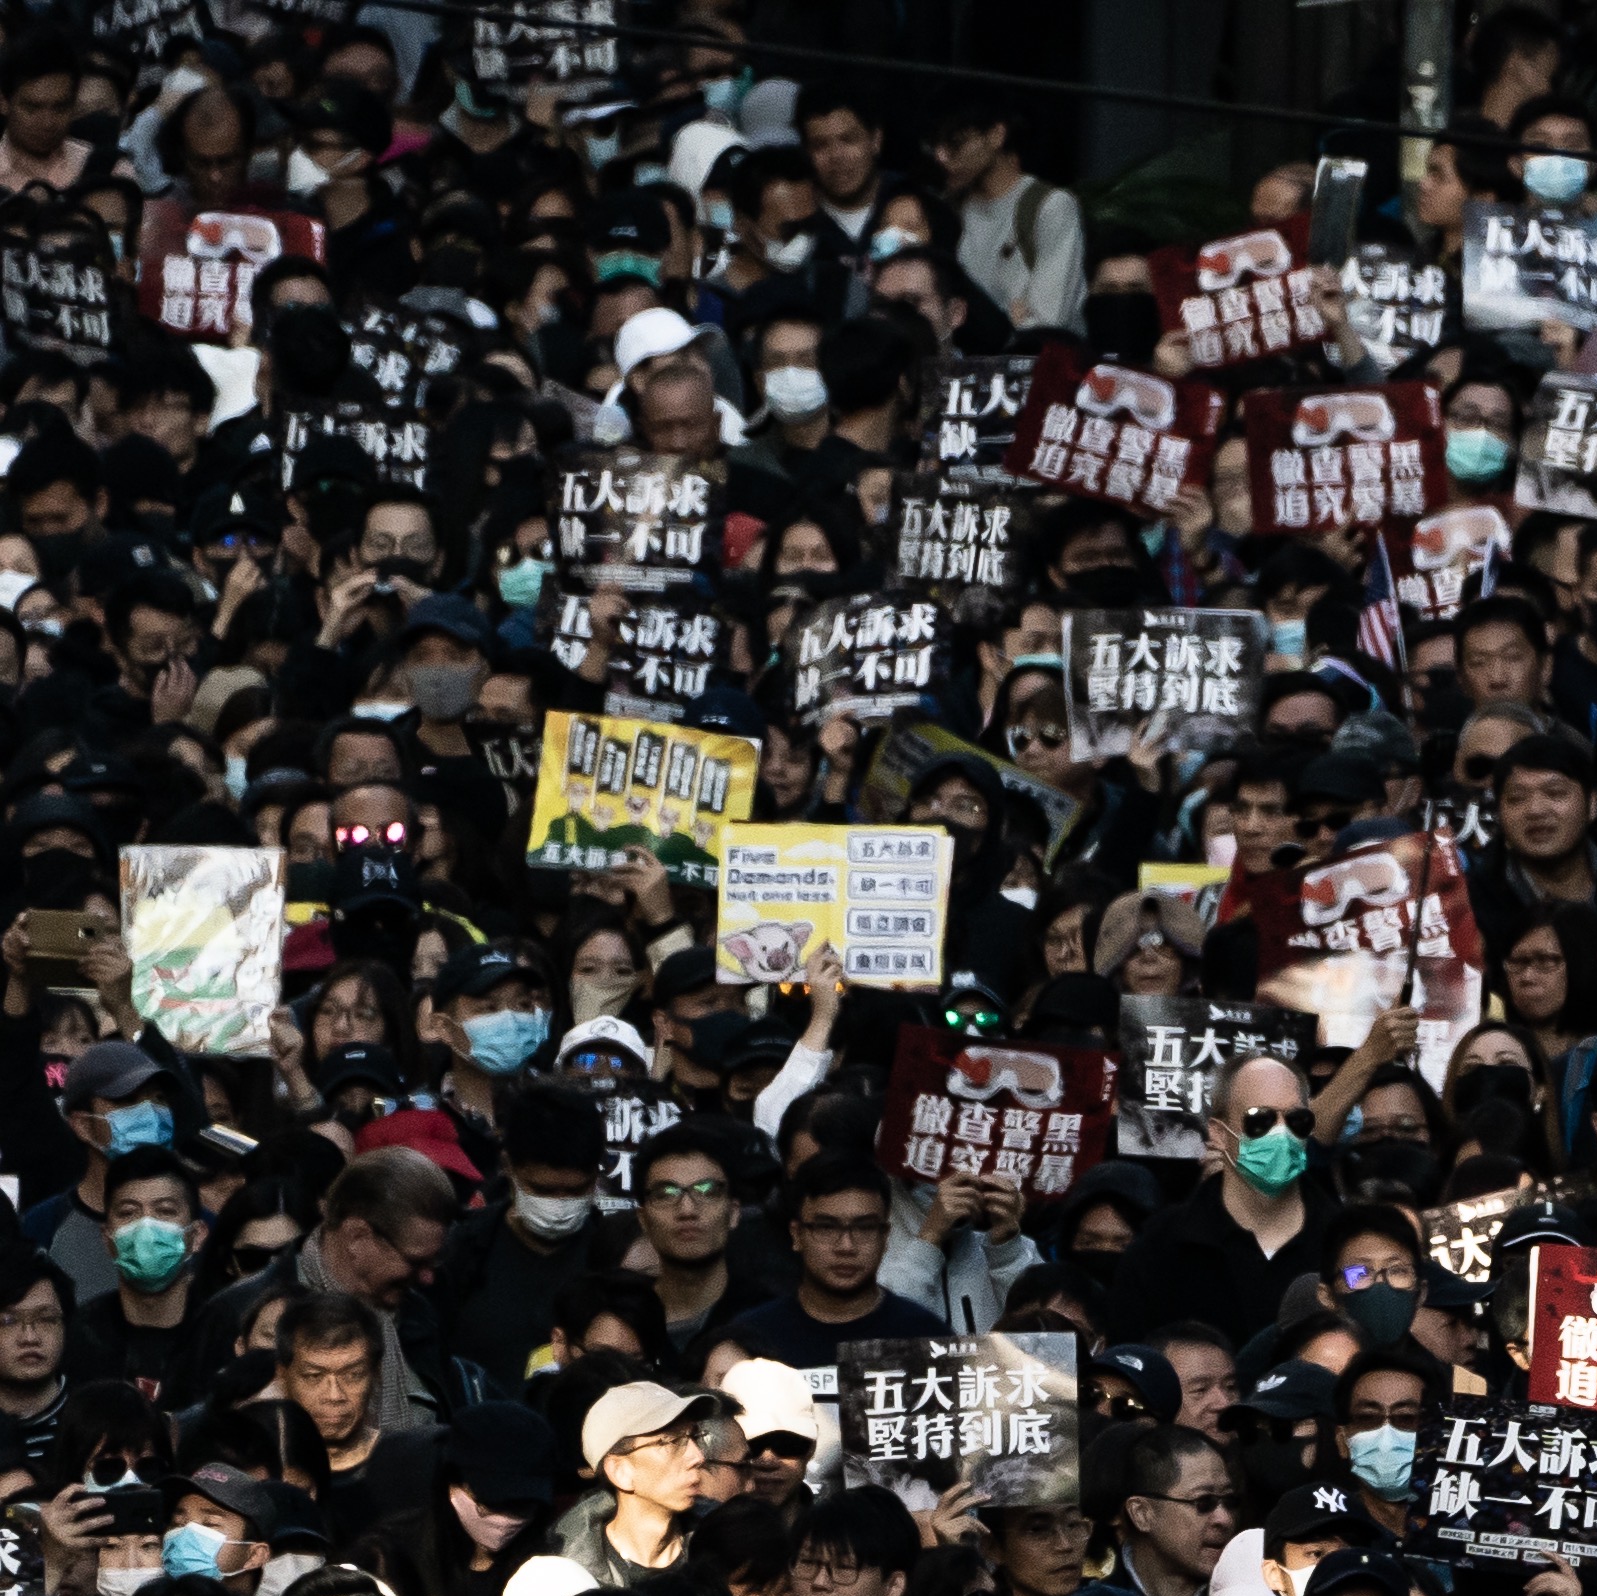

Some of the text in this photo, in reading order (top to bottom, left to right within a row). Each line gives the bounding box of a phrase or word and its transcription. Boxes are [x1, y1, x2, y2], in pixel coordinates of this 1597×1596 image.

[1085, 632, 1243, 677] 五大訴求
[1085, 673, 1242, 713] 堅持到底
[912, 1093, 1083, 1153] 徹查警黑
[864, 1367, 1052, 1413] 五大訴求
[868, 1412, 1053, 1462] 堅持到底
